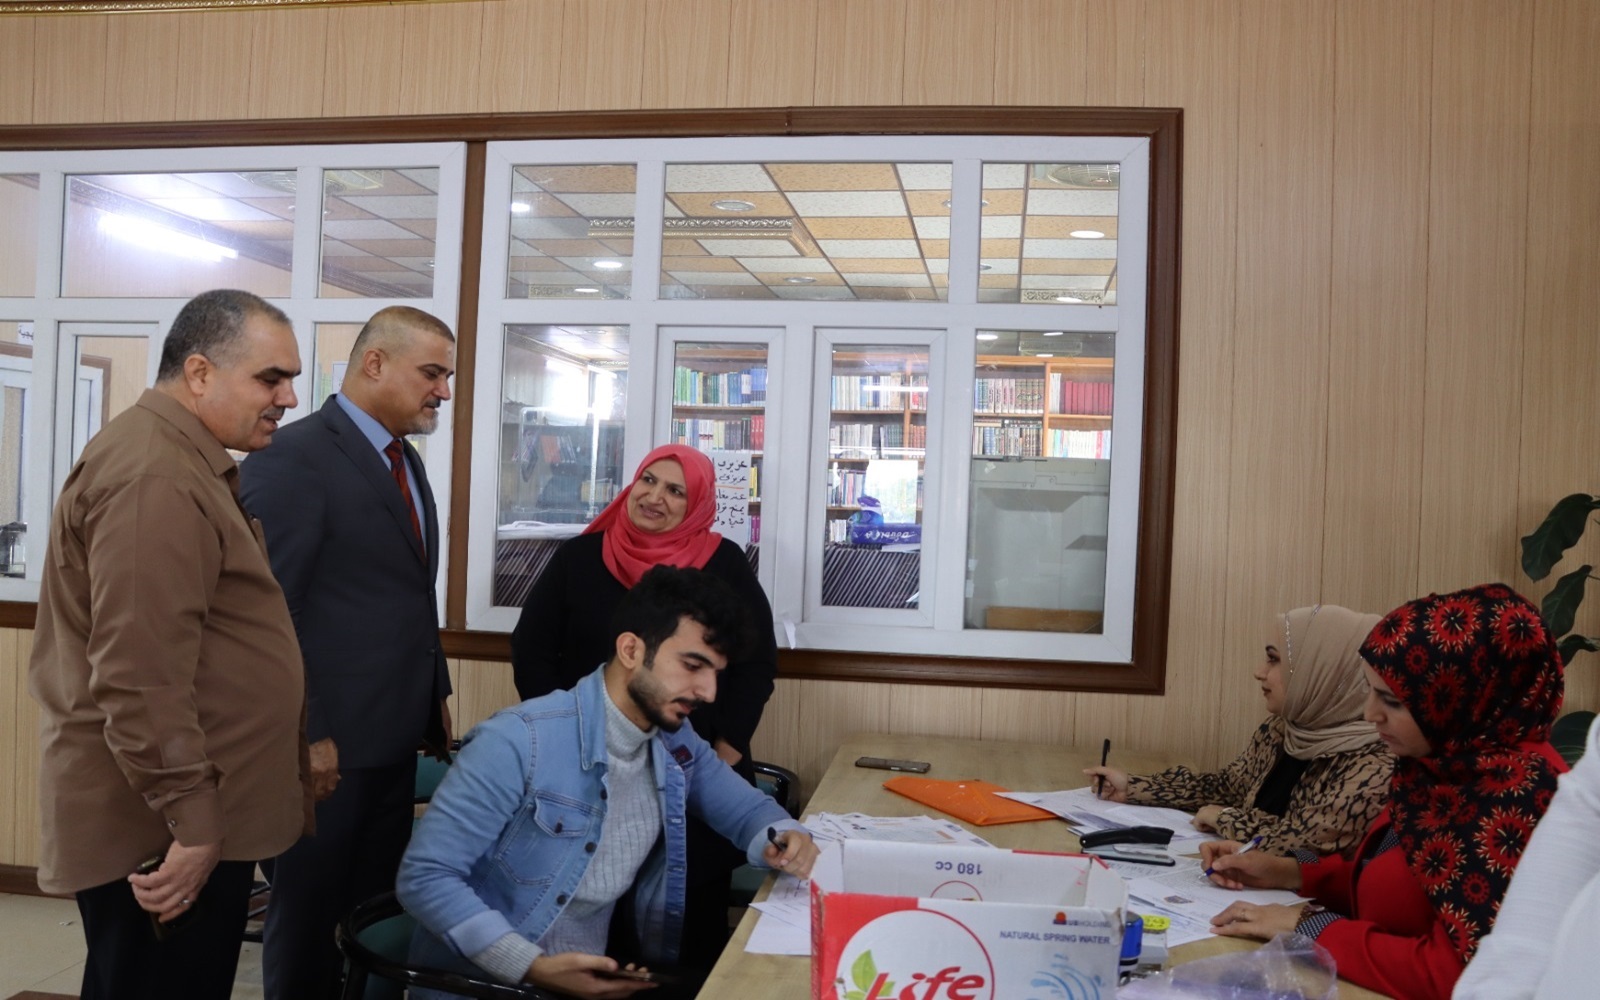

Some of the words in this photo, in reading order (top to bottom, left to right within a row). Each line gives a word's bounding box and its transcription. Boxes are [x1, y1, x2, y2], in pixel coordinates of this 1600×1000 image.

[935, 861, 953, 871] cc
[957, 862, 983, 875] 180
[999, 930, 1041, 941] NATURAL
[1043, 932, 1076, 943] SPRING
[1079, 934, 1111, 945] WATER
[865, 966, 985, 1000] Life
